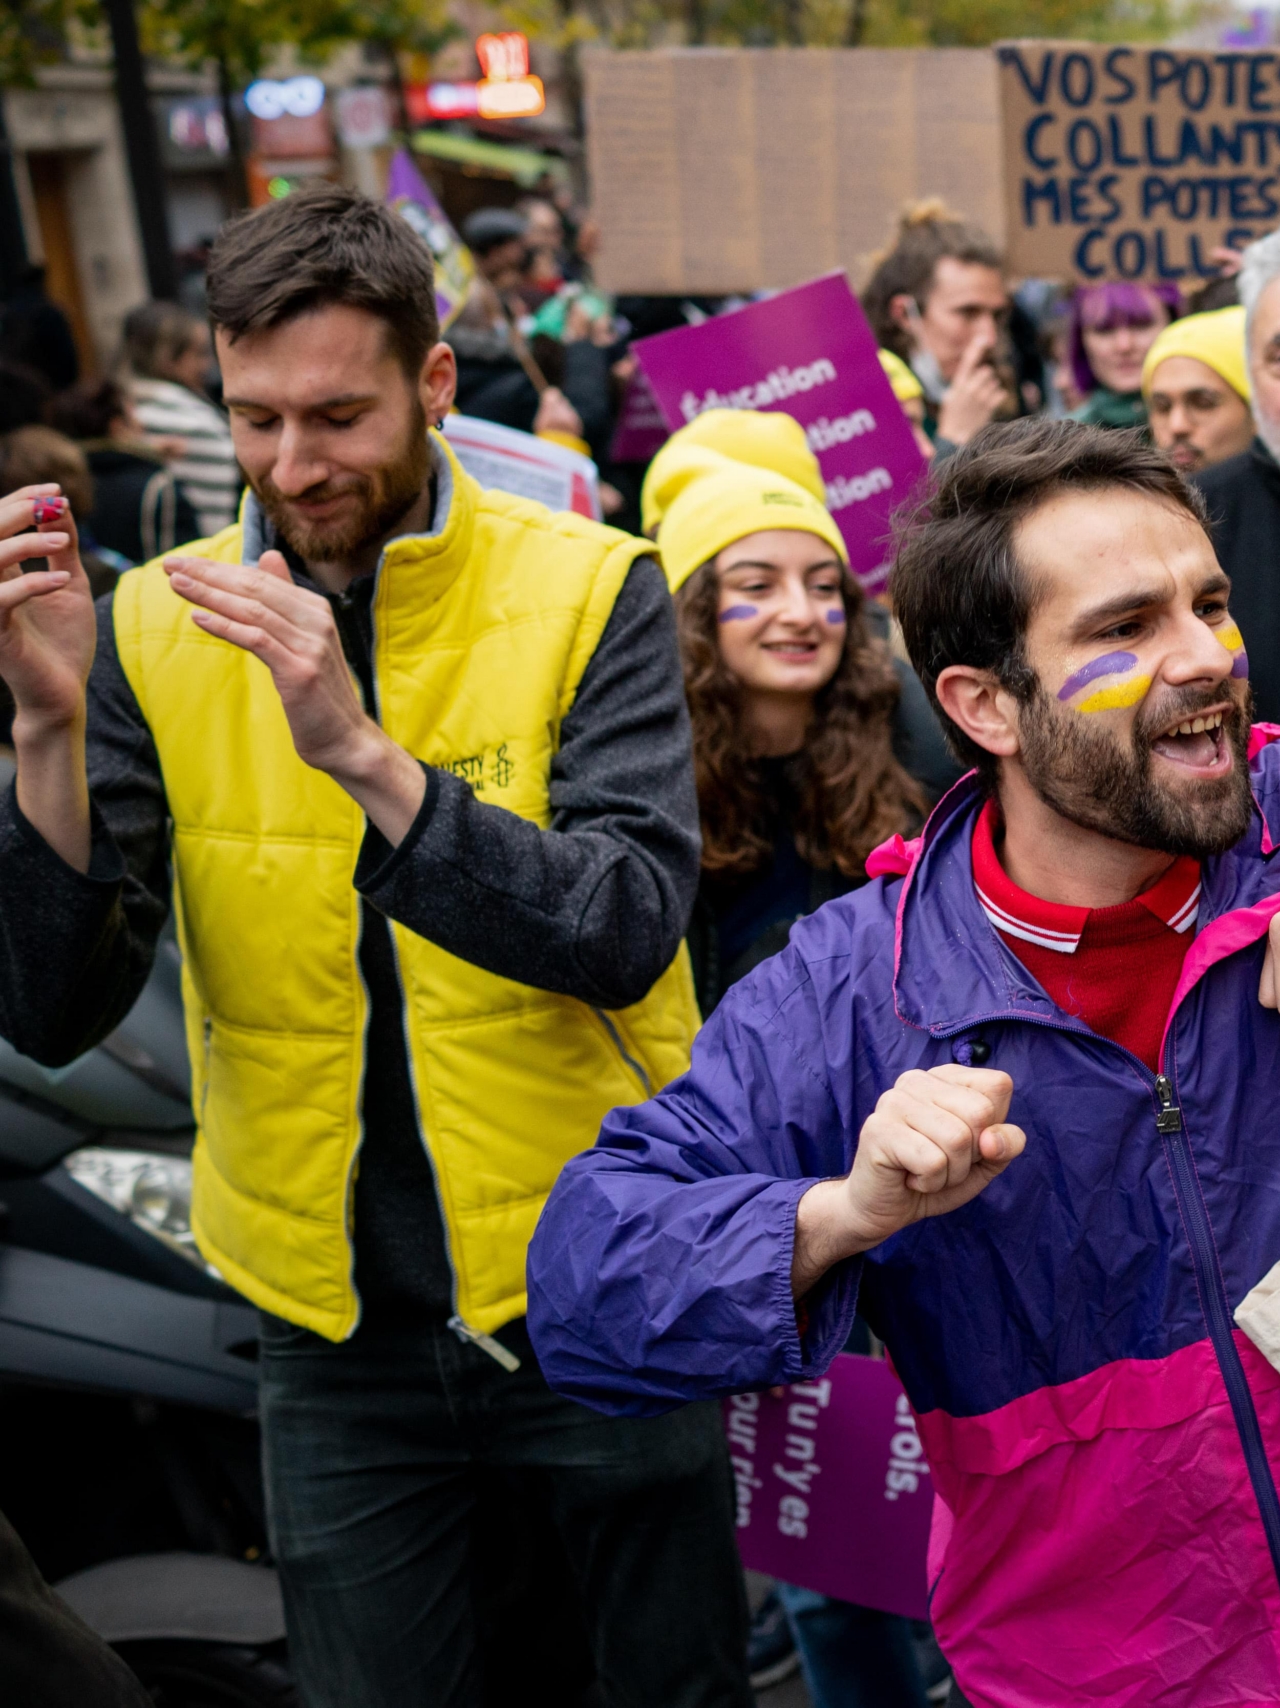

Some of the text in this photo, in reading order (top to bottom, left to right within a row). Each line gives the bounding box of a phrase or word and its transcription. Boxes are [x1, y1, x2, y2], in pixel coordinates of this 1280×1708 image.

[997, 46, 1136, 107] VOS
[1022, 174, 1121, 226] MES
[1140, 175, 1280, 222] POTES
[727, 1392, 760, 1454] our
[772, 1379, 832, 1540] Tu n'y es
